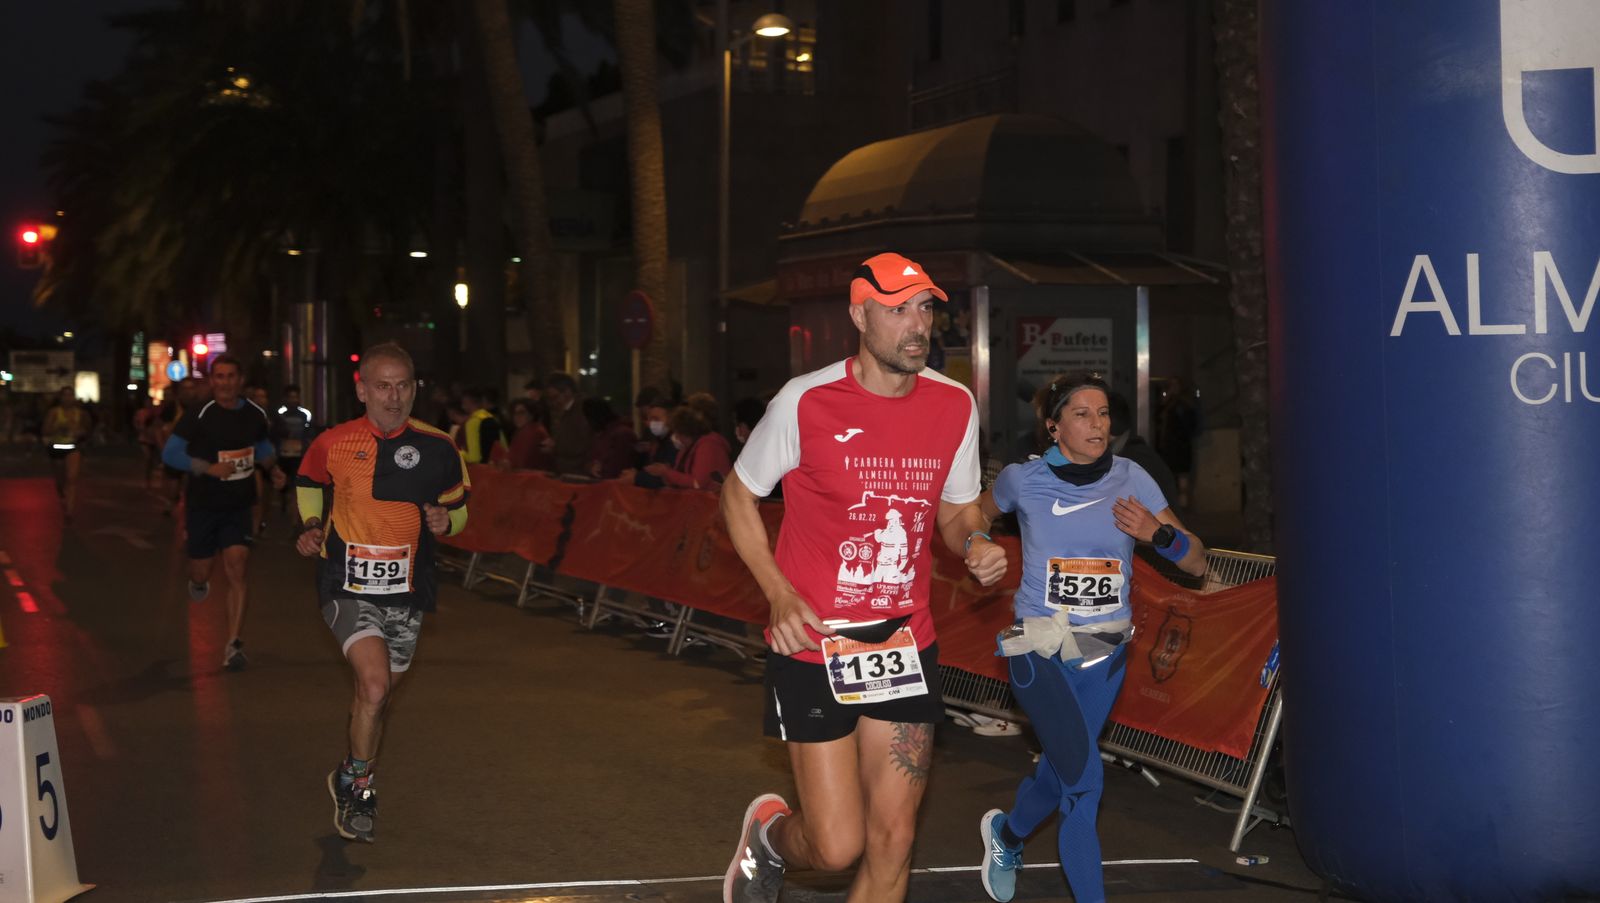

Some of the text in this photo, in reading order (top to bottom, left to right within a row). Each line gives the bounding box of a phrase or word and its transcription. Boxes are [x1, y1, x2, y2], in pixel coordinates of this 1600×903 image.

[1051, 332, 1108, 346] Bufete
[854, 457, 941, 470] CARRERA BOMBEROS
[905, 471, 934, 481] CIUDAD
[896, 482, 908, 490] DEL
[848, 512, 877, 522] 26.02.22
[359, 560, 400, 578] 159
[1062, 575, 1112, 596] 526
[846, 650, 905, 681] 133
[23, 701, 51, 723] MONDO
[35, 751, 59, 841] 5
